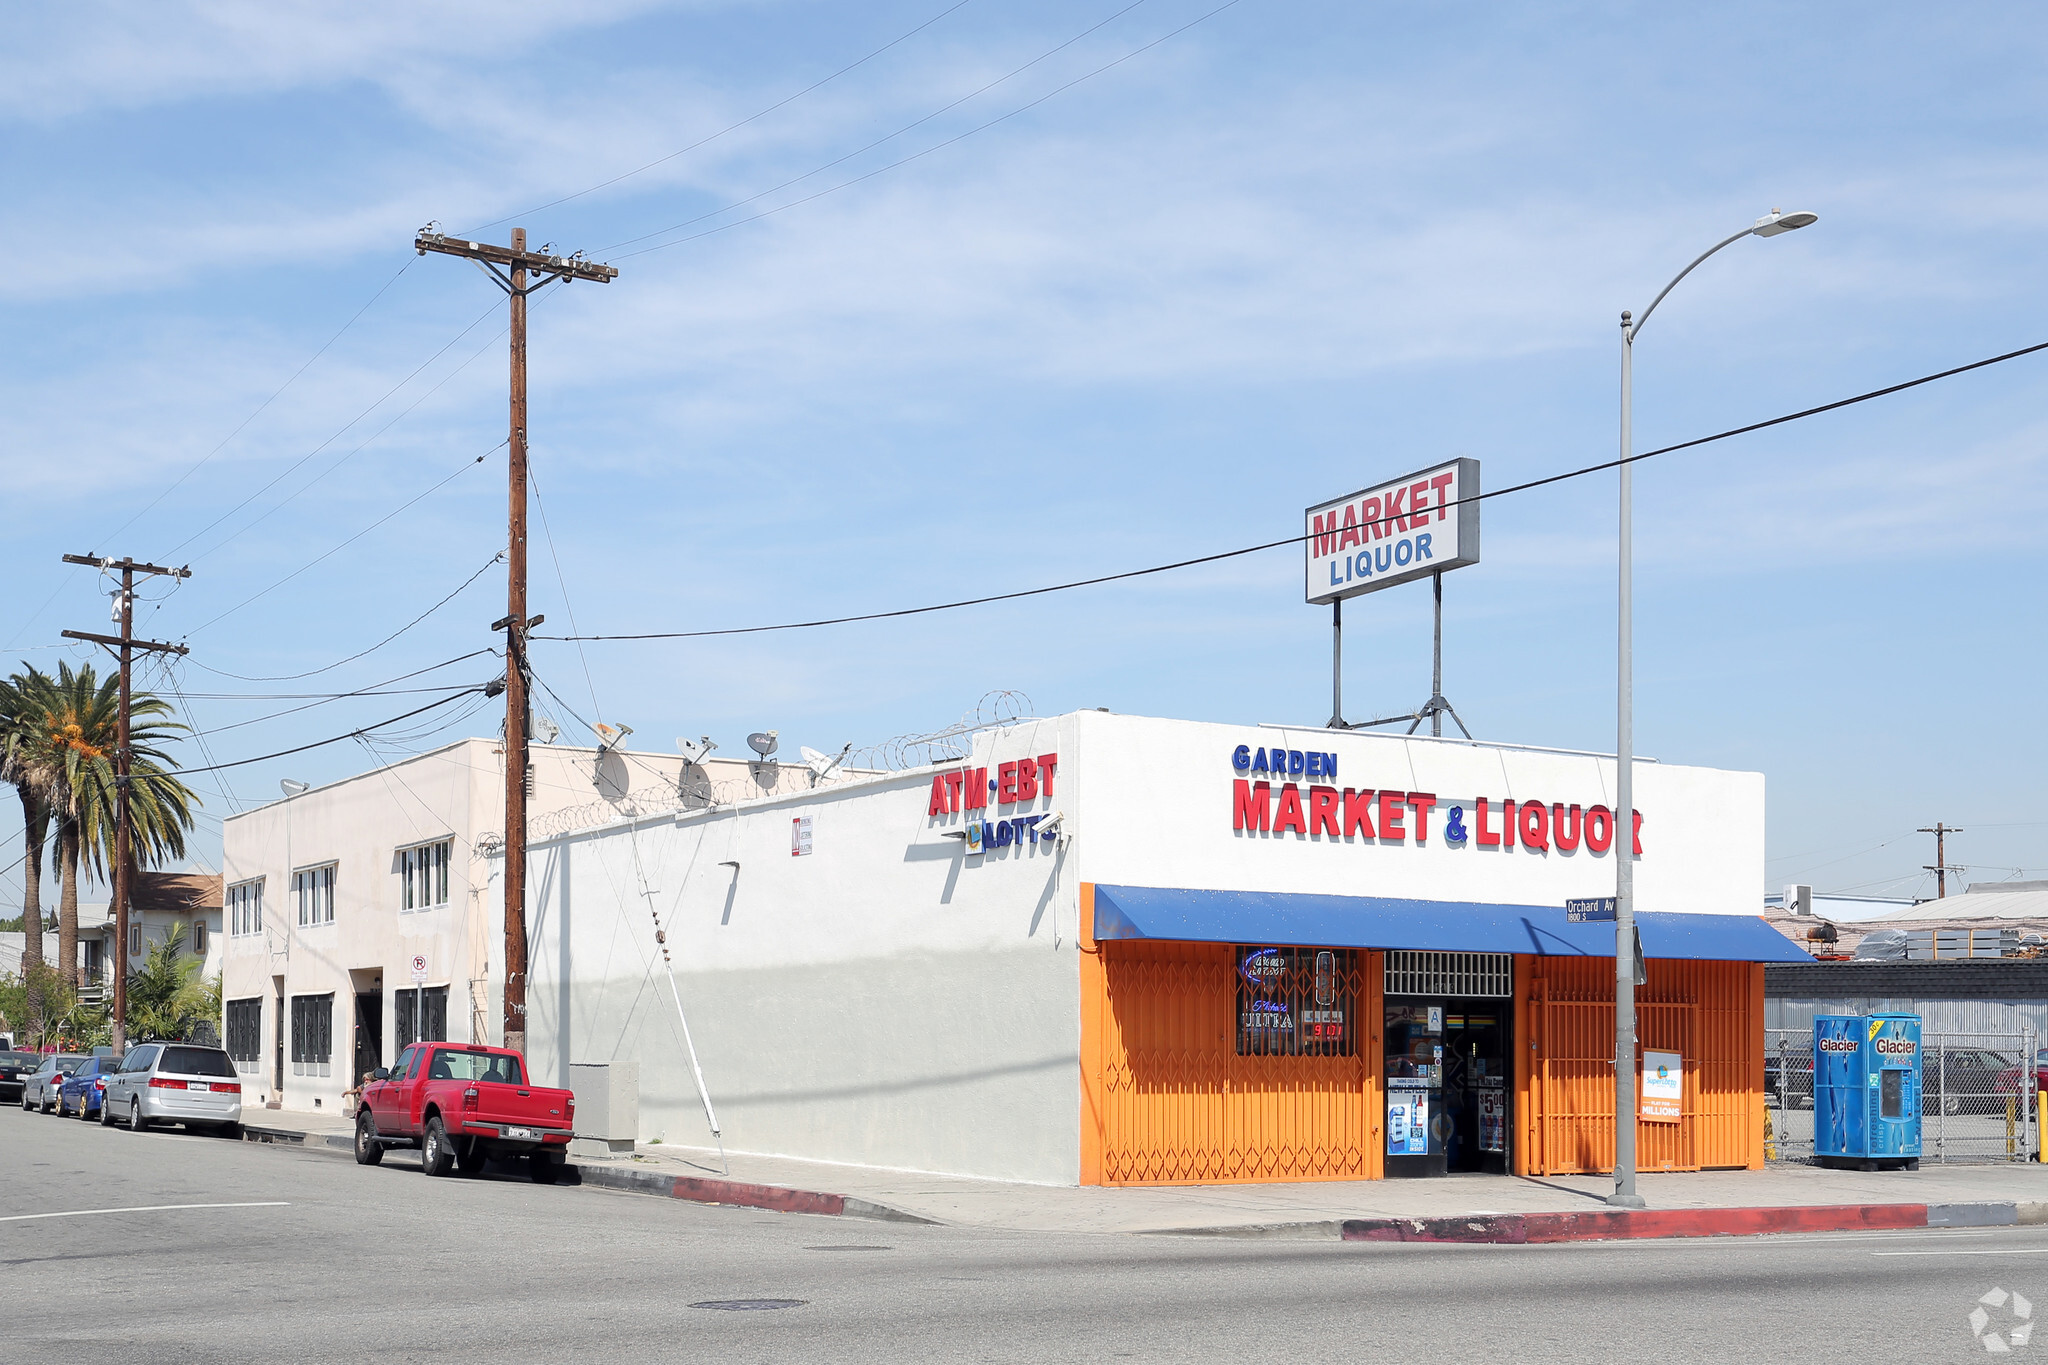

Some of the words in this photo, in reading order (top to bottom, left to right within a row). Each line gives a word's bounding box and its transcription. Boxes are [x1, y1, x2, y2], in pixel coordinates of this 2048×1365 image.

[1313, 472, 1453, 559] MARKET
[1330, 533, 1433, 586] LIQUOR
[1233, 744, 1337, 777] GARDEN
[1233, 779, 1436, 840] MARKET
[1444, 804, 1468, 843] &
[1567, 899, 1599, 913] Orchard
[1604, 898, 1615, 912] Av
[1582, 912, 1587, 921] S
[1430, 1010, 1440, 1023] A
[1819, 1038, 1859, 1052] Glacier
[1876, 1038, 1916, 1054] Glacier
[1641, 1105, 1681, 1117] MILLIONS
[1877, 1123, 1885, 1149] crisp
